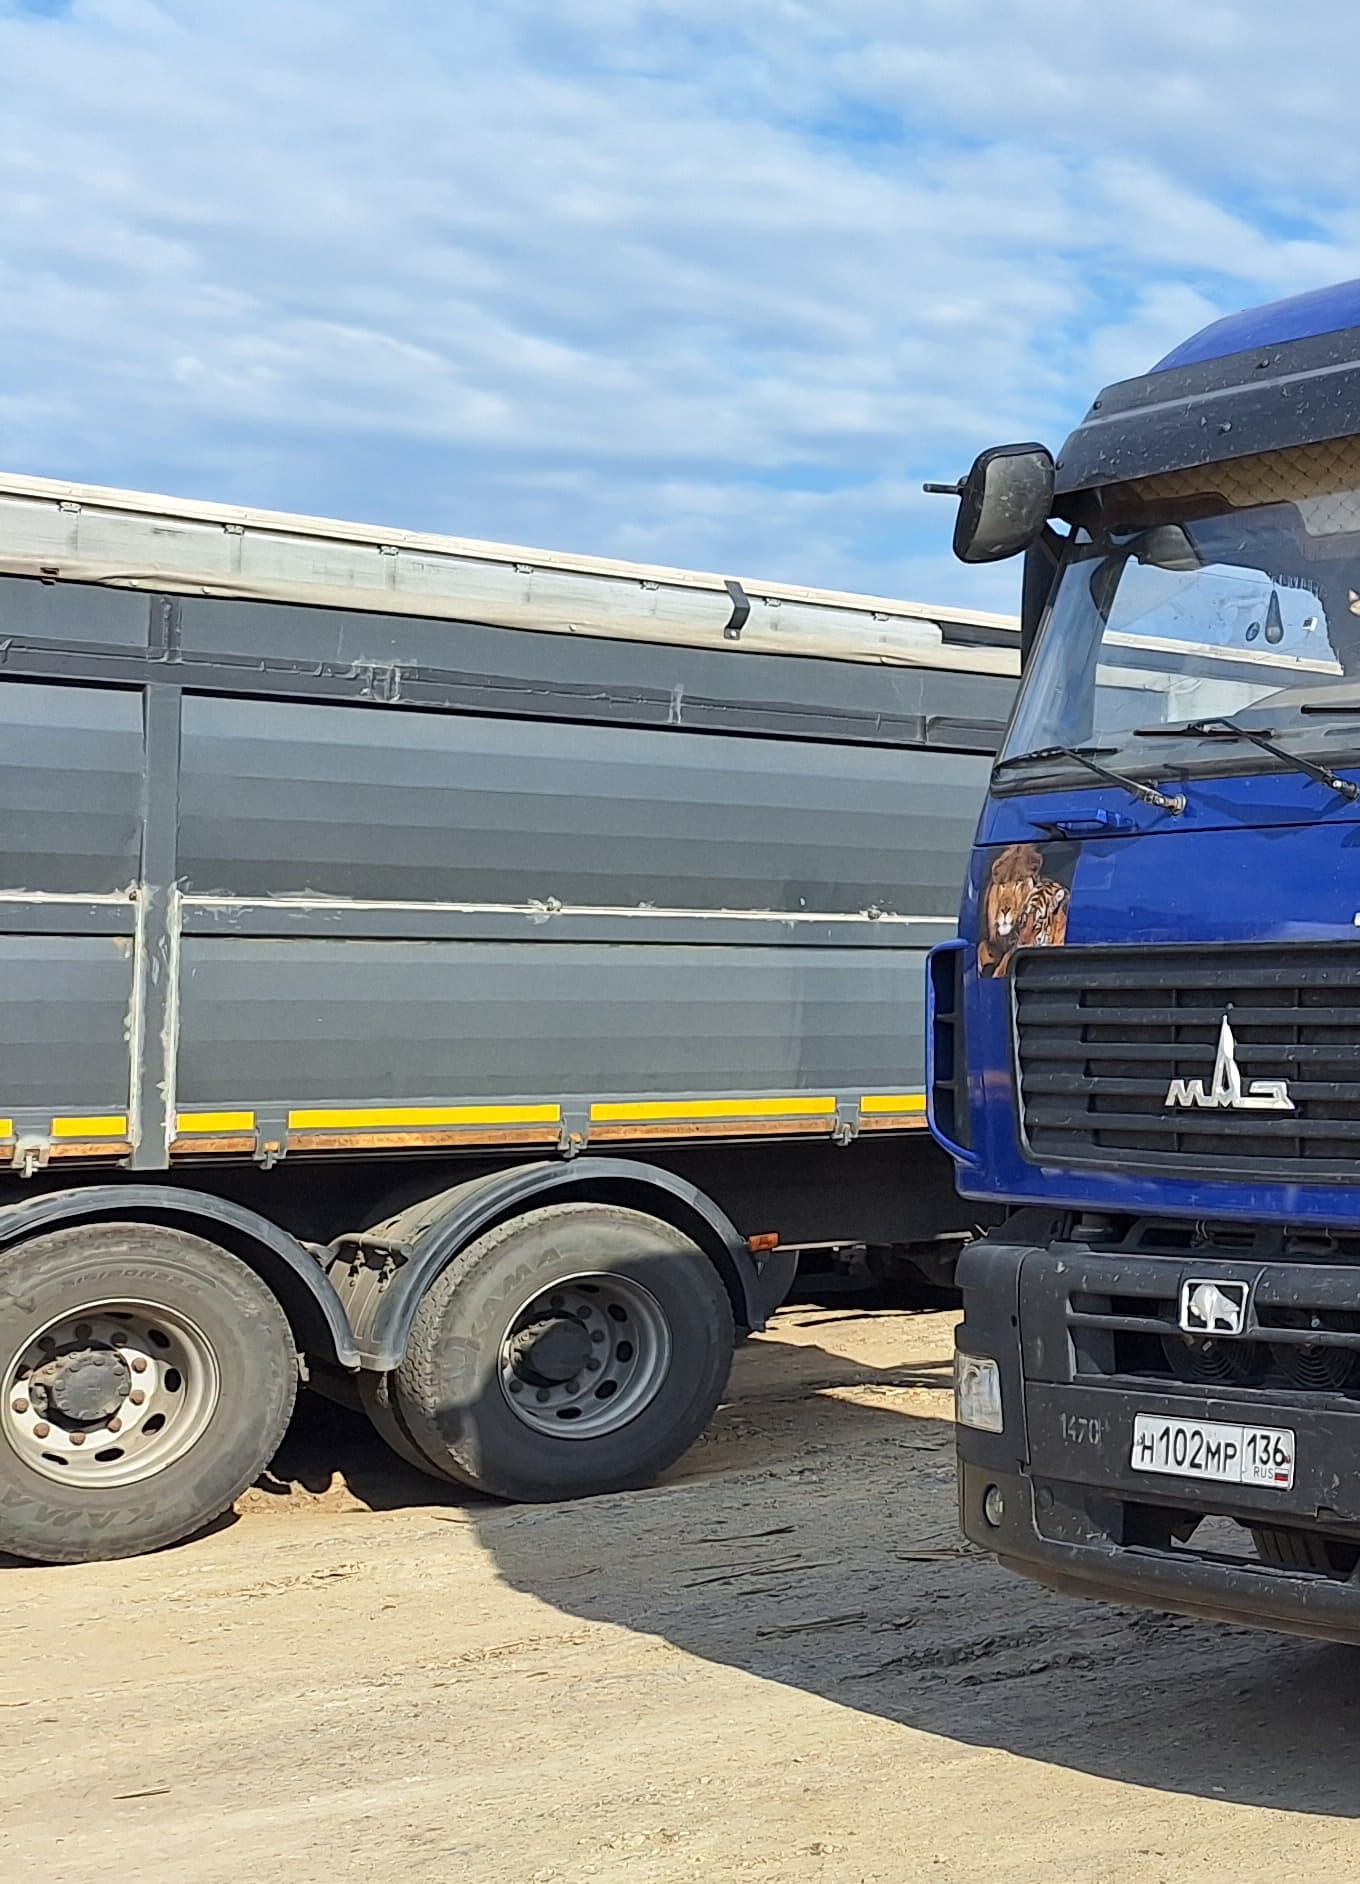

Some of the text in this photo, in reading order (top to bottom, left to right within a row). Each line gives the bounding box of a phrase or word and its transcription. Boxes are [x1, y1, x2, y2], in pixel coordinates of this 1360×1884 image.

[1059, 1412, 1100, 1445] 1470
[1248, 1433, 1285, 1467] 136
[1253, 1466, 1274, 1480] RUS
